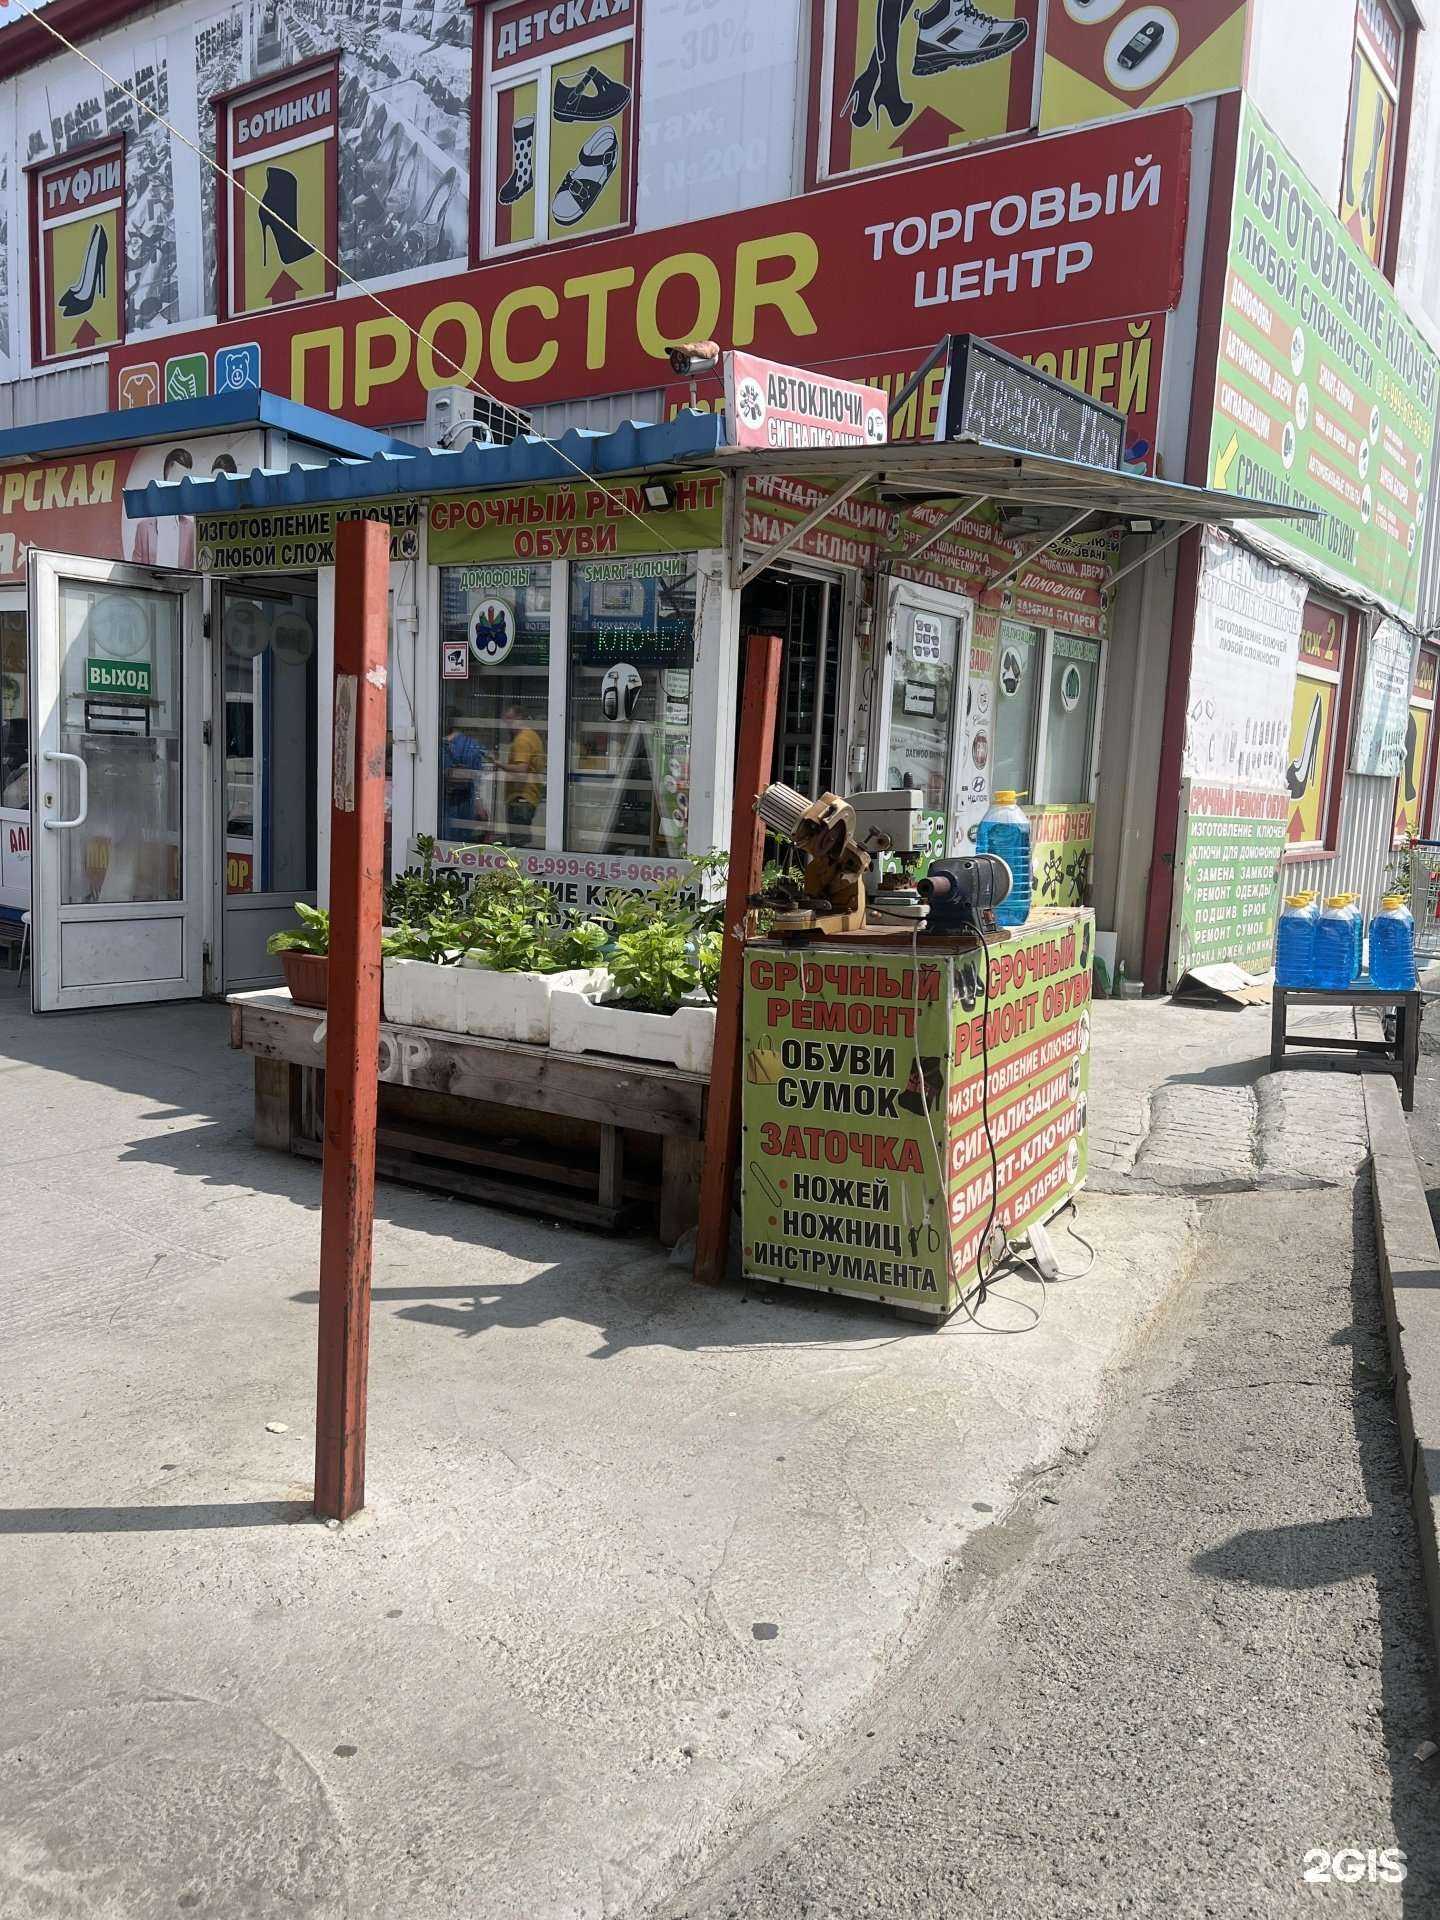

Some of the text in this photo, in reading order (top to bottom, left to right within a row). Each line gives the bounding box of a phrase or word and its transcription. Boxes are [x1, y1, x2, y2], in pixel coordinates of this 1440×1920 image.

[237, 87, 333, 145] БОТИНКИ
[46, 160, 121, 209] ТУФЛИ
[864, 153, 1162, 261] ТОРГОВЫЙ
[913, 241, 1094, 308] ЦЕНТР
[1244, 130, 1387, 353] ИЗГОТОВЛЕНИЕ
[1385, 312, 1438, 412] КЛЮЧЕЙ
[290, 232, 820, 411] ПРОСТОR
[1238, 216, 1374, 389] ЛЮБОЙ СЛОЖНОСТИ
[767, 373, 864, 427] АВТОКЛЮЧИ
[0, 459, 116, 515] РСКАЯ
[430, 477, 721, 531] СРОЧНЫЙ РЕМНТ
[199, 511, 331, 542] ИЗГОТОВЛЕНИЕ
[513, 523, 618, 559] ОБУВИ
[1327, 515, 1355, 565] ОБУВИ
[213, 539, 276, 569] ЛЮБОЙ
[583, 558, 683, 583] SMART-КЛЮЧИ
[458, 568, 531, 592] ДОМОФОНЫ
[1020, 573, 1086, 601] ДОМОФОНЫ
[1324, 617, 1336, 661] 2
[89, 666, 149, 691] ВЫХОД
[1027, 811, 1093, 843] ТОКЛЮЧЕЙ
[1191, 822, 1254, 838] ИЗГОТОВЛЕНИЕ
[526, 855, 679, 883] 8-999-615-9668
[1196, 865, 1274, 883] ЗАМЕНА ЗАМКОВ
[1222, 846, 1239, 862] ДЛЯ
[1195, 902, 1267, 924] ПОДШИВ БРЮК
[1196, 883, 1272, 902] РЕМОНТ ОДЕЖДЫ
[1194, 921, 1265, 945] РЕМОНТ СУМОК
[750, 959, 941, 1002] СРОЧНЫЙ
[987, 925, 1076, 1000] СРОЧНЫЙ
[767, 997, 922, 1038] РЕМОНТ
[954, 967, 1092, 1067] РЕМОНТ ОБУВИ
[780, 1038, 896, 1080] ОБУВИ
[951, 1024, 1078, 1118] ИЗГОТОВЛЕНИЕ КЛЮЧЕЙ
[776, 1076, 901, 1119] СУМОК
[952, 1072, 1067, 1171] СИГНАЛИЗАЦИИ
[760, 1121, 925, 1174] ЗАТОЧКА
[951, 1108, 1076, 1225] SMART-КЛЮЧИ
[793, 1171, 890, 1213] НОЖЕЙ
[1013, 1157, 1067, 1219] БАТАРЕЙ
[782, 1209, 903, 1258] НОЖНИЦ
[753, 1240, 938, 1293] ИНСТРУМАЕНТА
